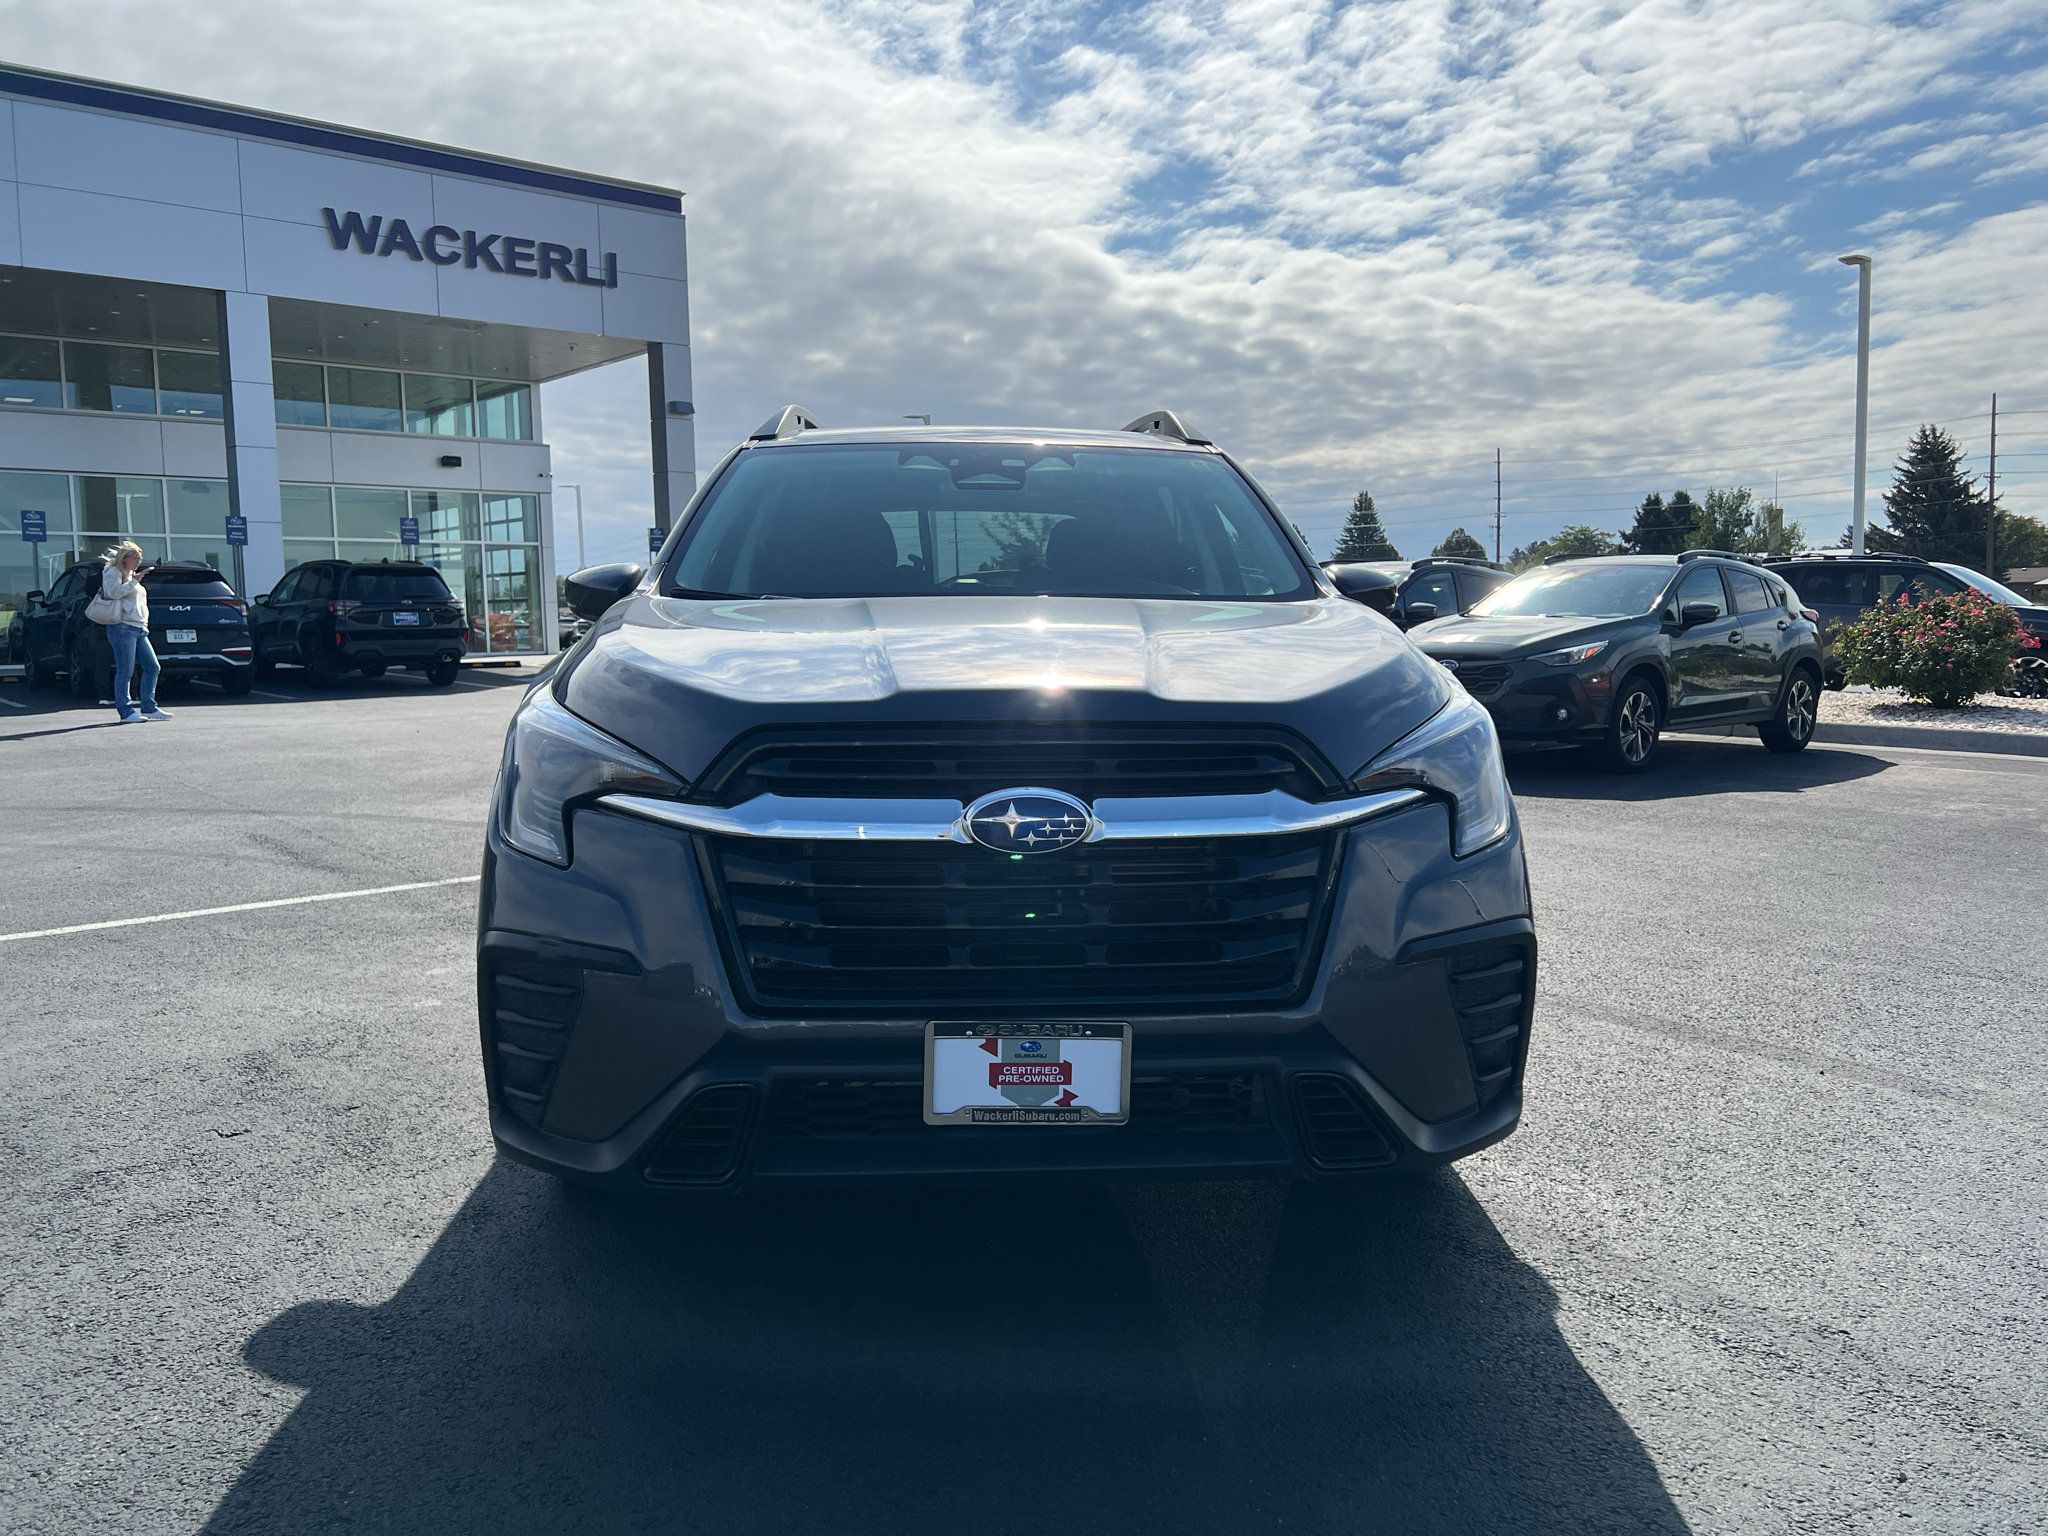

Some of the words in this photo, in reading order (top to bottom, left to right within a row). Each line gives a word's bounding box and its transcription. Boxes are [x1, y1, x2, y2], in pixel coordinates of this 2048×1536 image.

[321, 206, 618, 289] WACKERLI
[998, 1024, 1084, 1037] SUBARU
[1003, 1066, 1060, 1075] CERTIFIED
[998, 1074, 1064, 1083] PRE-OWNED
[973, 1110, 1080, 1121] WackerliSubaru.com
